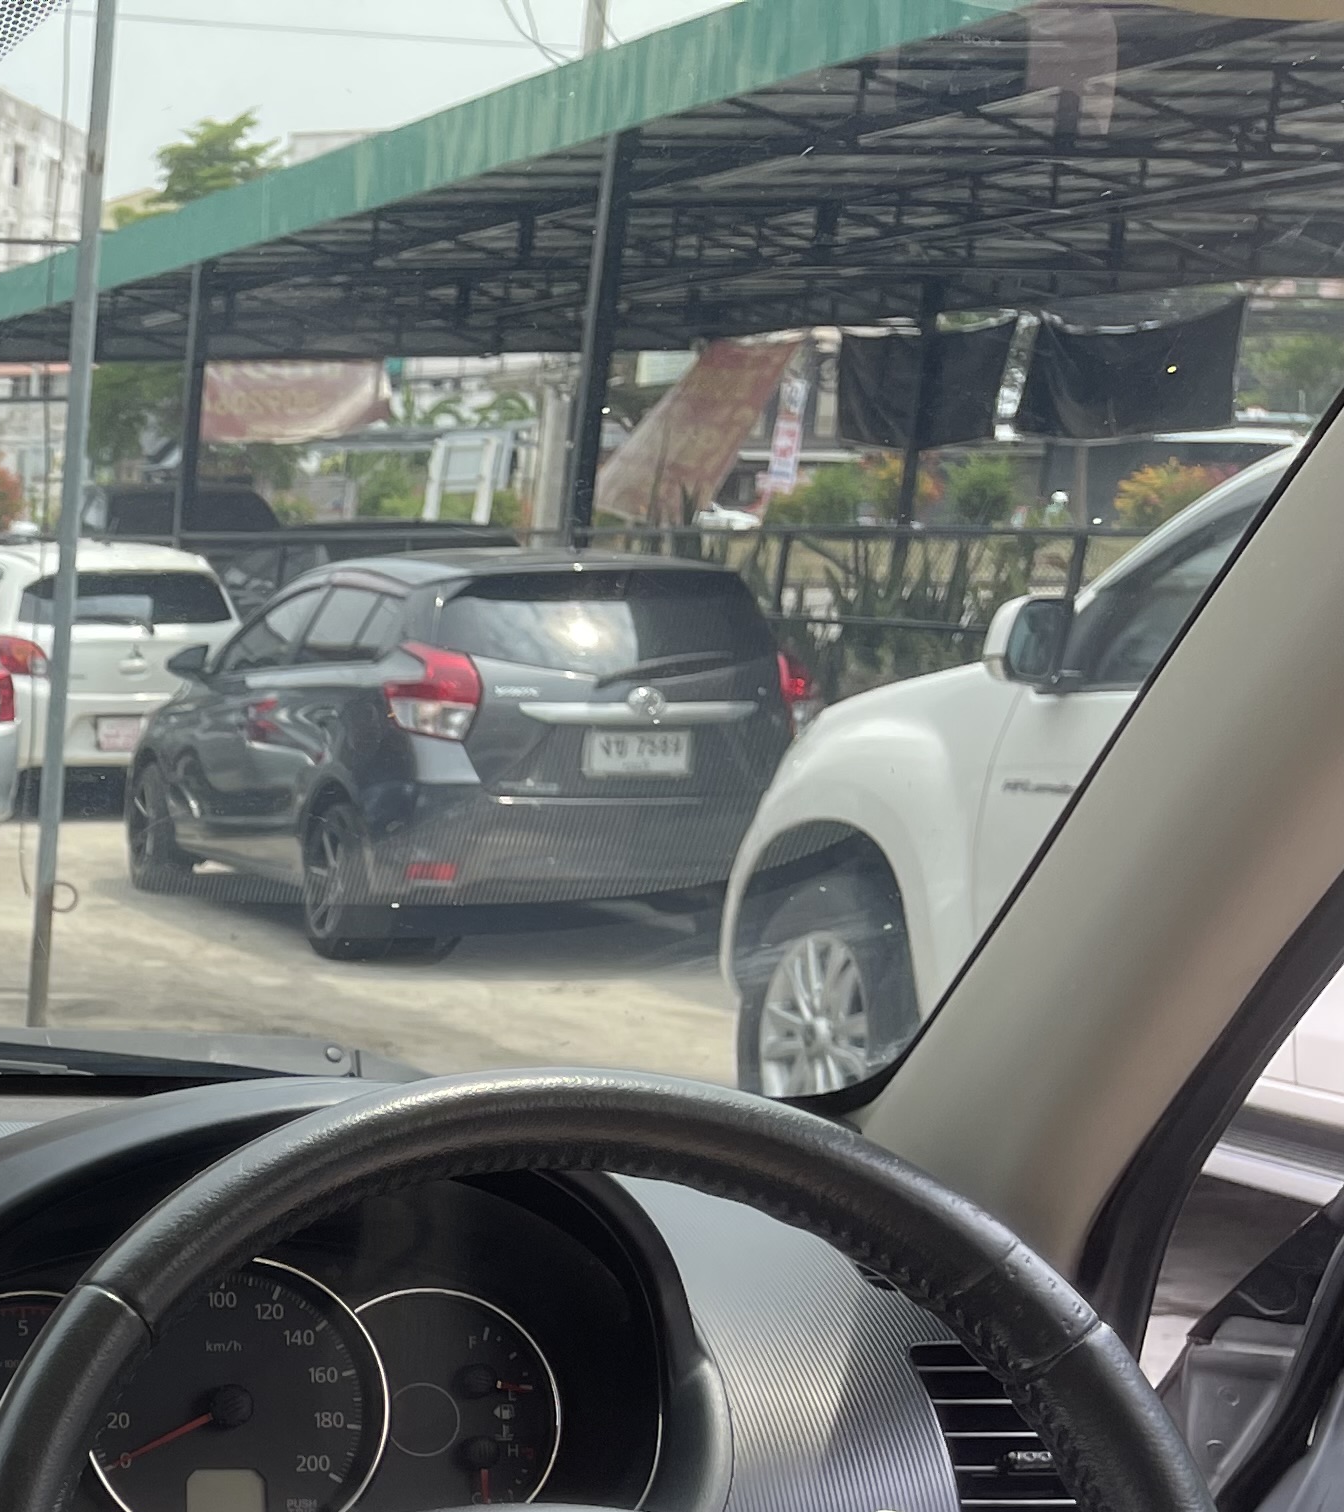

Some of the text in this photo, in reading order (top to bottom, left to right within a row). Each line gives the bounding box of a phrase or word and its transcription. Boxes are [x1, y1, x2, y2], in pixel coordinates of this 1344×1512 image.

[207, 1291, 237, 1308] 100
[255, 1303, 284, 1320] 120
[18, 1320, 29, 1336] 5
[206, 1340, 242, 1352] km/h
[283, 1329, 314, 1346] 140
[308, 1366, 338, 1383] 160
[106, 1412, 130, 1429] 20
[314, 1411, 344, 1428] 180
[296, 1455, 330, 1472] 200
[287, 1499, 317, 1509] PUSH
